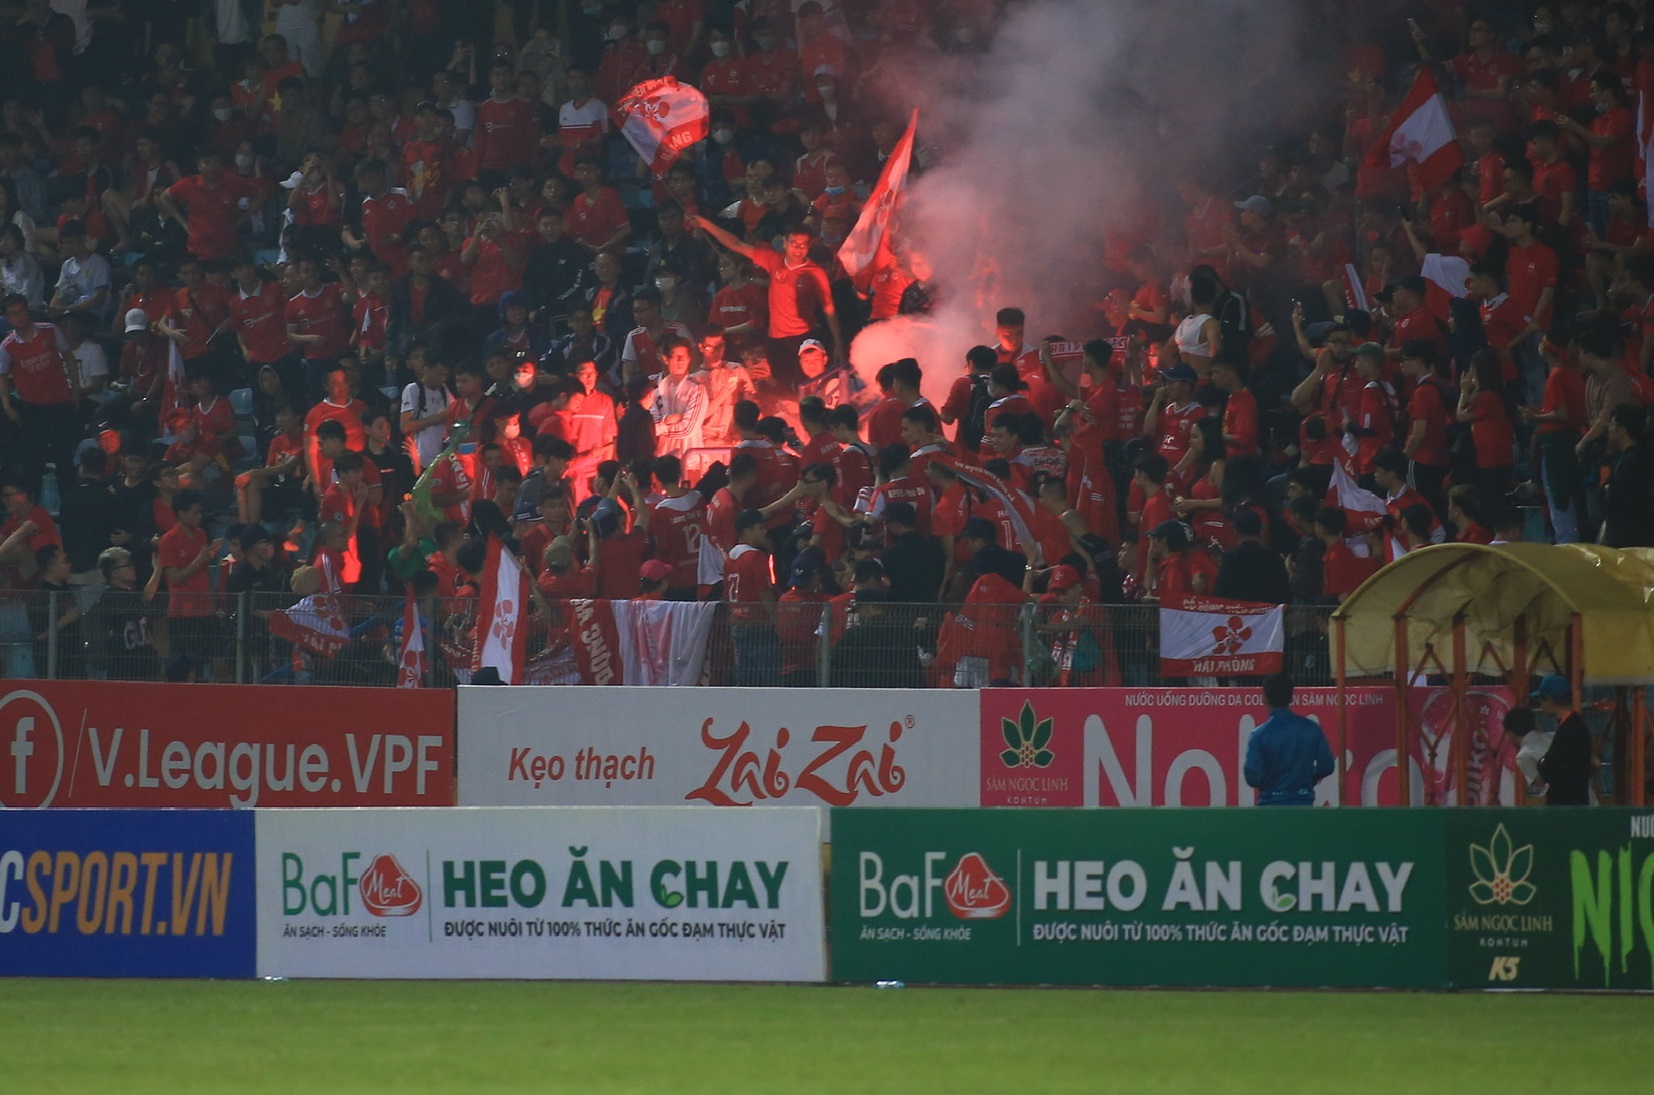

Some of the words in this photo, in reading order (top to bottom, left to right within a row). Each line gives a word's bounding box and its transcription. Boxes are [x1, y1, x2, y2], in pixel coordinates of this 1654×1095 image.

[1125, 691, 1154, 706] NƯỚC
[1157, 691, 1186, 706] UỐNG
[1189, 692, 1225, 706] DƯỠNG
[1228, 694, 1243, 706] DA
[1359, 694, 1383, 706] LINH
[88, 727, 443, 808] V.League.VPF
[508, 747, 565, 789] Kẹo
[575, 747, 655, 789] thạch
[1042, 778, 1068, 791] LINH
[282, 852, 361, 917] BaF
[367, 870, 408, 905] Meat
[443, 859, 547, 909] HEO
[561, 845, 634, 908] ĂN
[650, 859, 789, 909] CHAY
[860, 851, 946, 918] BaF
[951, 870, 1003, 906] Meat
[1034, 860, 1147, 911] HEO
[1161, 846, 1242, 911] ĂN
[1259, 860, 1415, 912] CHAY
[283, 922, 297, 938] ĂN
[299, 926, 325, 941] SẠCH
[333, 922, 359, 938] SỐNG
[444, 919, 485, 941] ĐƯỢC
[488, 918, 522, 937] NUÔI
[525, 917, 545, 937] TỪ
[547, 921, 581, 937] 100%
[584, 918, 622, 938] THỨC
[625, 918, 645, 938] ĂN
[649, 917, 678, 938] GỐC
[682, 922, 714, 942] ĐẠM
[717, 920, 756, 943] THỰC
[758, 920, 786, 943] VẬT
[859, 924, 876, 940] ĂN
[877, 927, 905, 942] SẠCH
[913, 924, 941, 941] SỐNG
[1033, 921, 1077, 944] ĐƯỢC
[1081, 920, 1118, 941] NUÔI
[1122, 920, 1143, 941] TỪ
[1145, 924, 1182, 941] 100%
[1186, 920, 1227, 942] THỨC
[1230, 921, 1251, 941] ĂN
[1256, 920, 1289, 942] GỐC
[1292, 925, 1329, 946] ĐẠM
[1332, 924, 1375, 947] THỰC
[1378, 922, 1409, 947] VẬT
[1520, 915, 1552, 932] LINH
